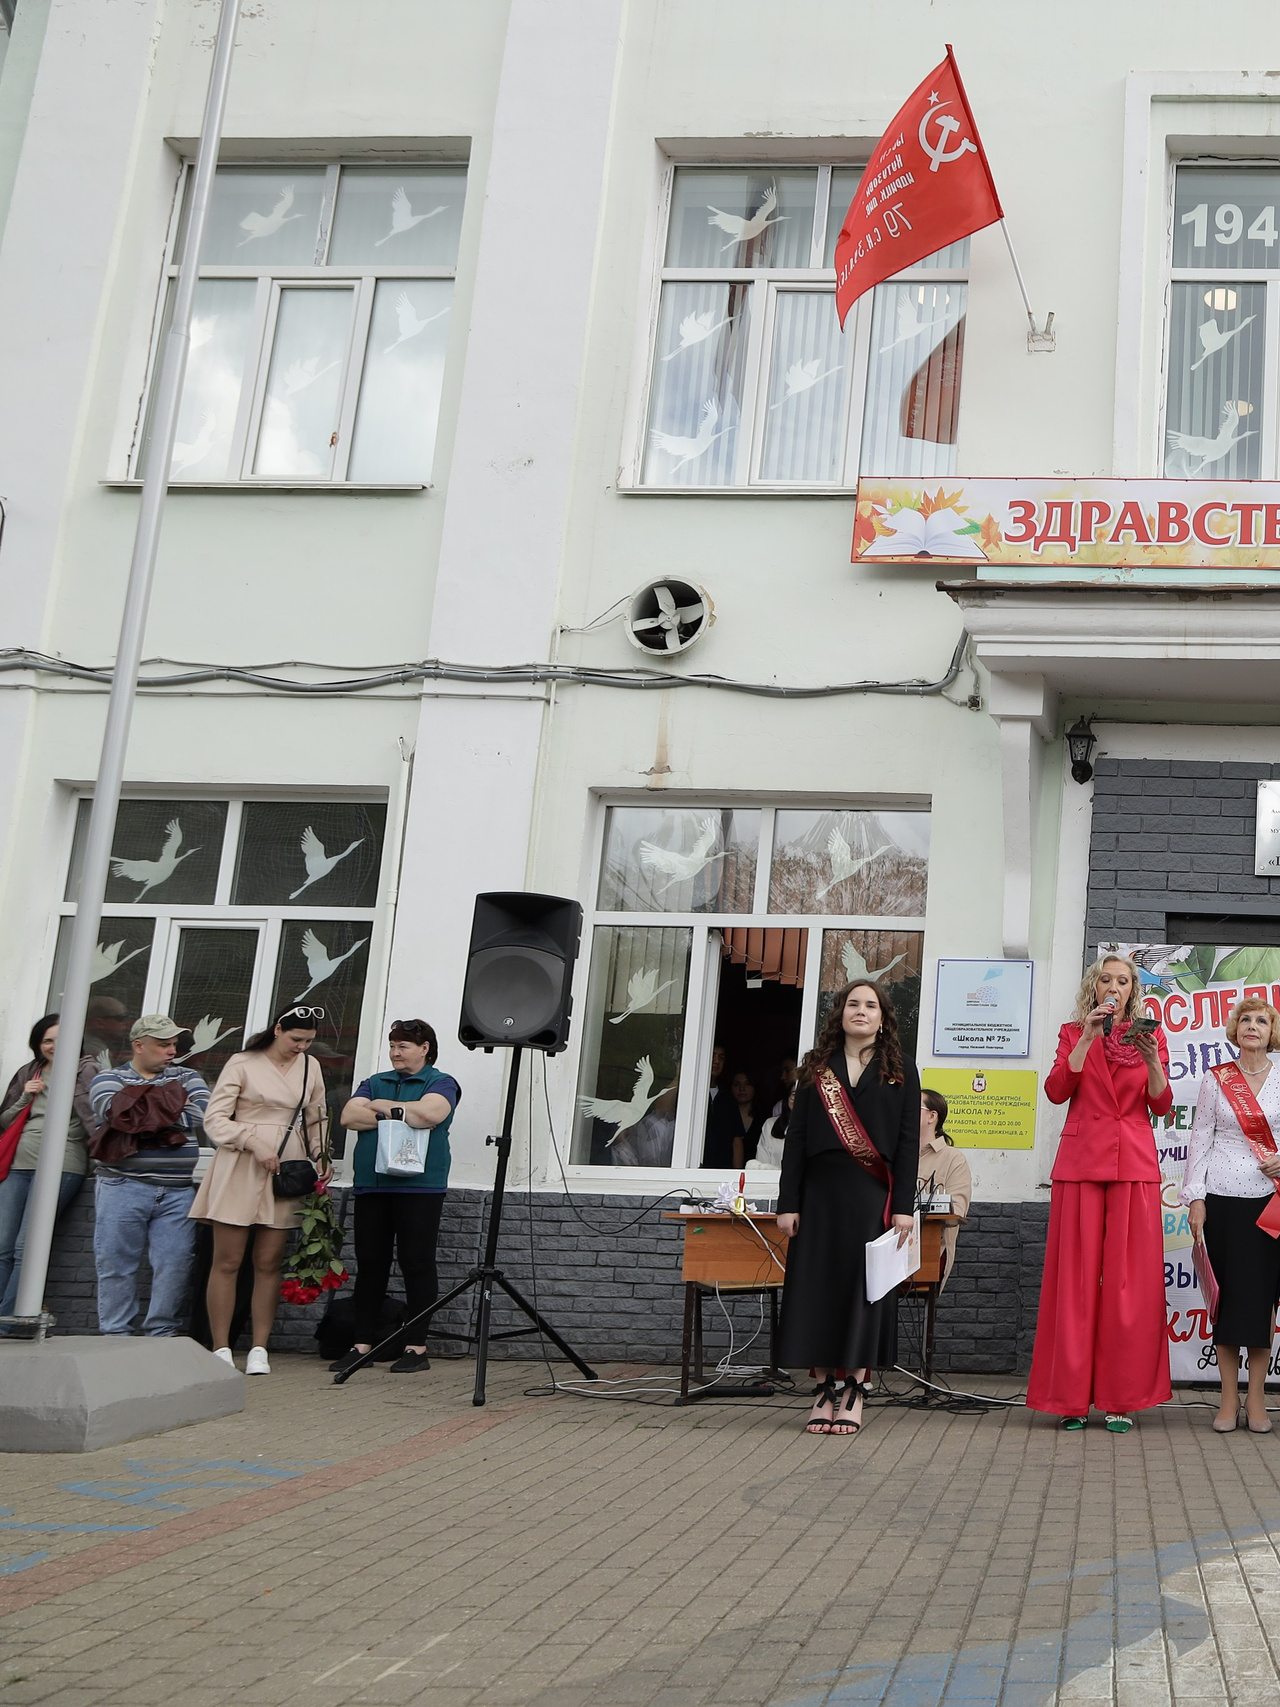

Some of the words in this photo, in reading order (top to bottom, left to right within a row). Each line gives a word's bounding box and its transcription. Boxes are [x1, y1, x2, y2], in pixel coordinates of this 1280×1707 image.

[952, 1035, 984, 1043] «Школа
[997, 1035, 1011, 1043] 75»
[949, 1108, 982, 1116] «ШКОЛА
[993, 1109, 1006, 1117] 75»
